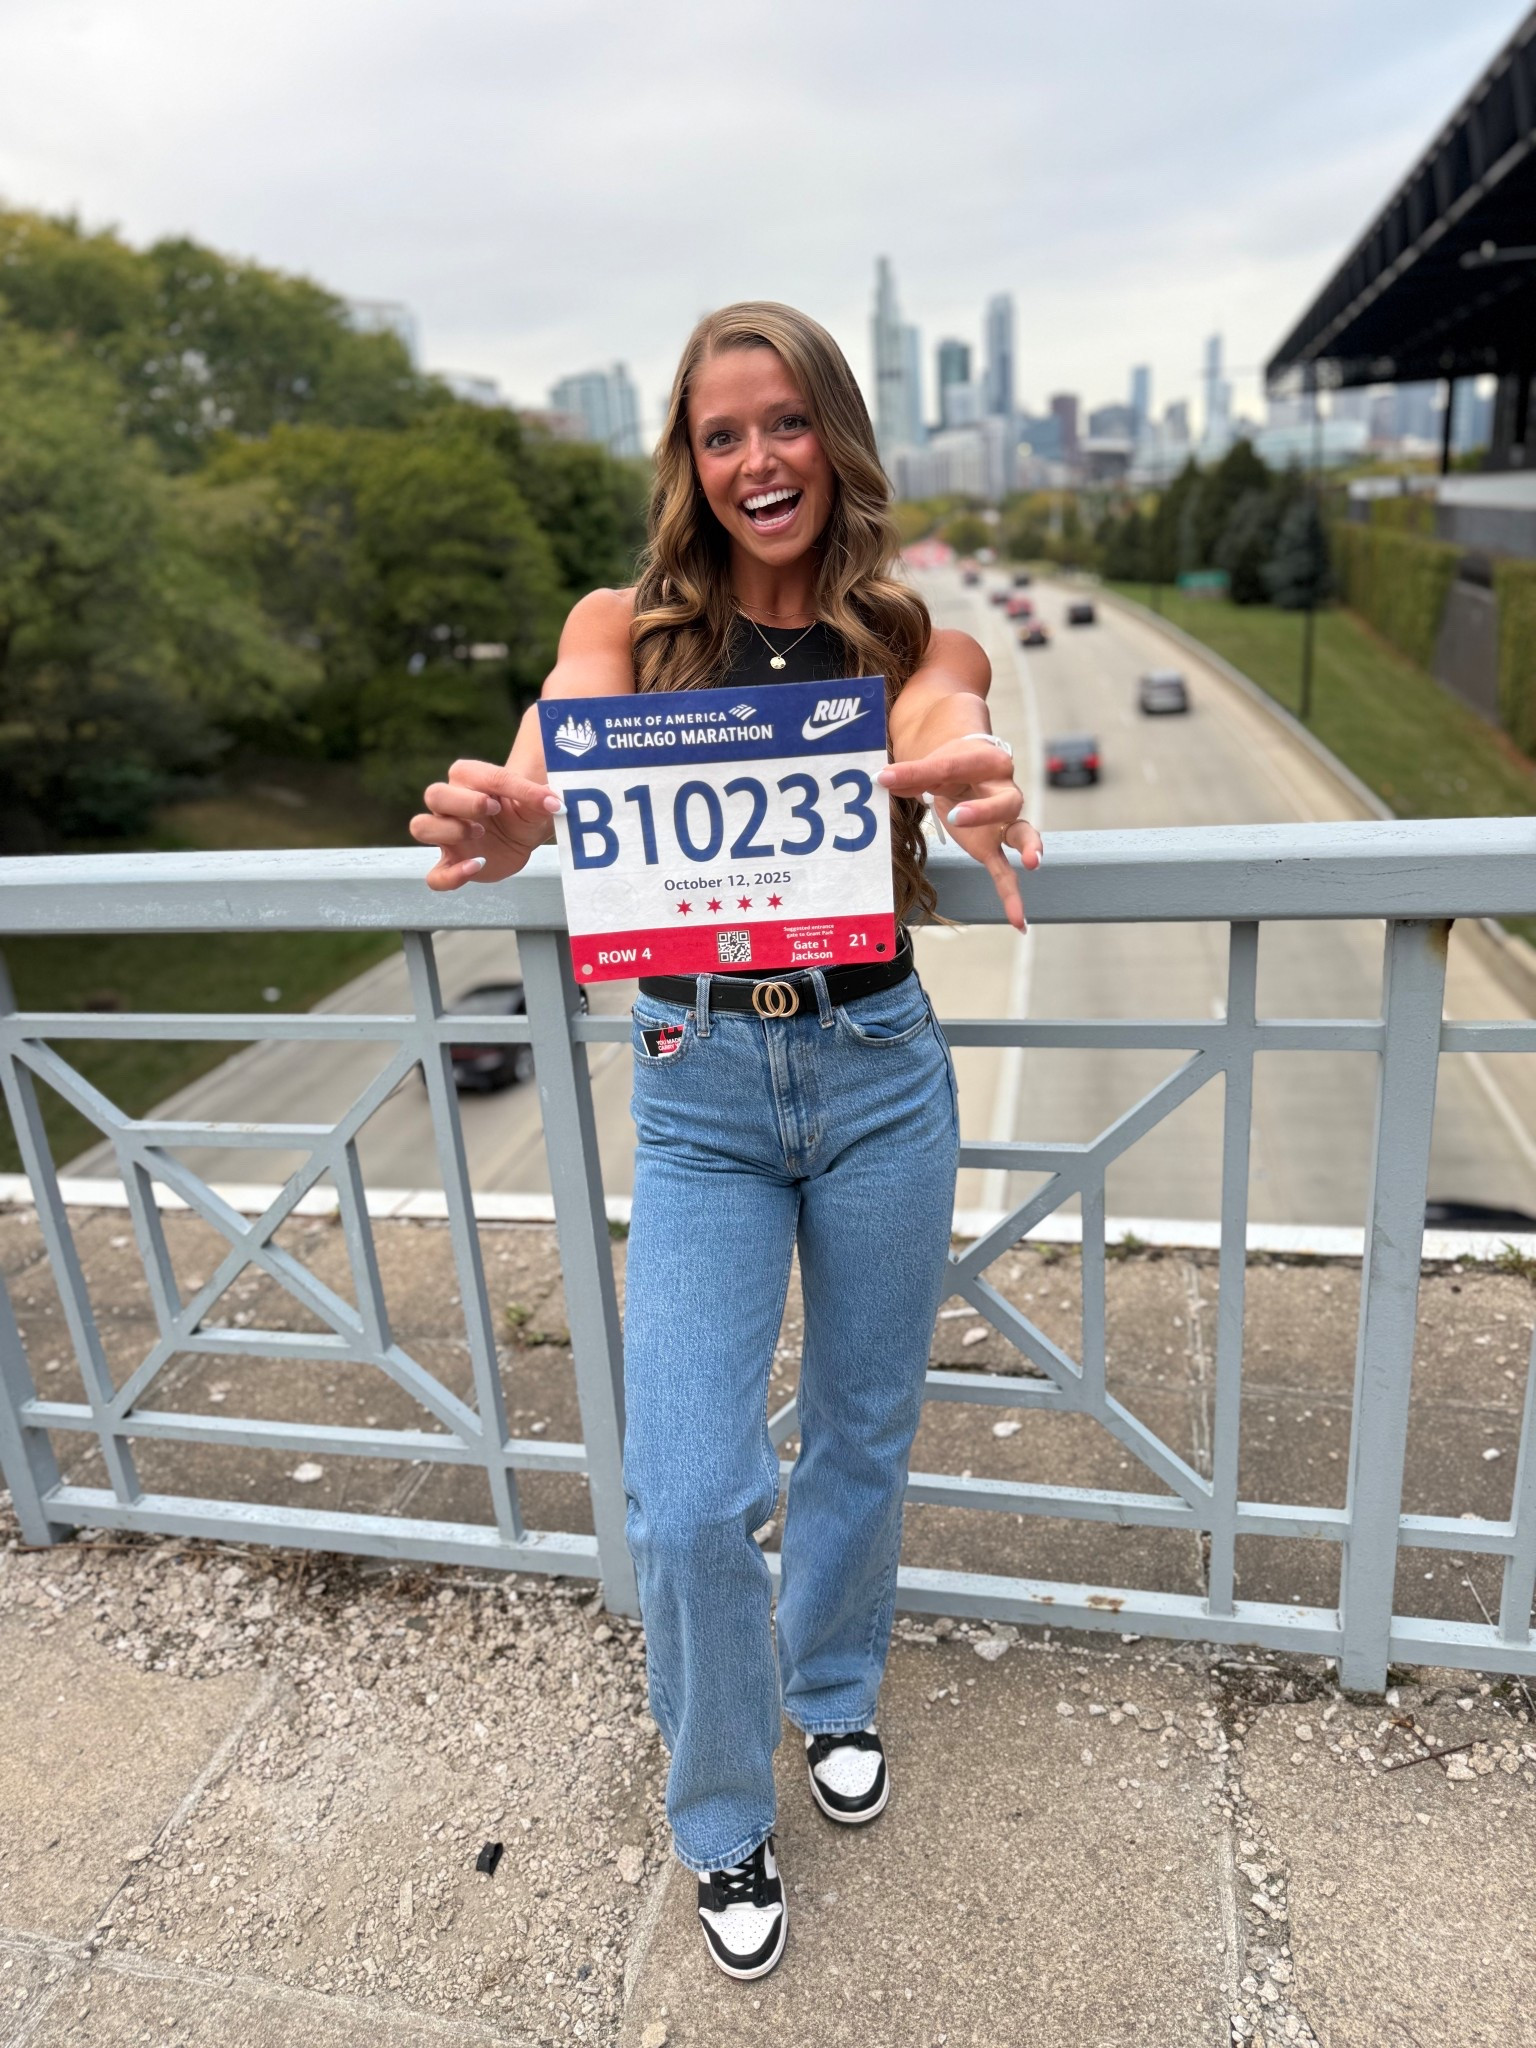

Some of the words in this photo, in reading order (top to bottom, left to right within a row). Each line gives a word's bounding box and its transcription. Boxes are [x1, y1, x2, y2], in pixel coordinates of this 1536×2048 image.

[812, 697, 861, 721] RUN
[605, 717, 642, 728] BANK
[645, 715, 662, 726] OF
[665, 712, 727, 725] AMERICA
[606, 731, 677, 749] CHICAGO
[681, 724, 773, 745] MARATHON
[562, 769, 878, 870] B10233
[664, 877, 722, 891] October
[727, 874, 750, 888] 12,
[754, 871, 791, 885] 2025
[783, 925, 810, 933] Suggested
[793, 940, 819, 950] Gate
[822, 939, 828, 948] 1
[849, 933, 867, 947] 21
[598, 949, 637, 964] ROW
[641, 947, 652, 960] 4
[791, 951, 833, 963] Jackson
